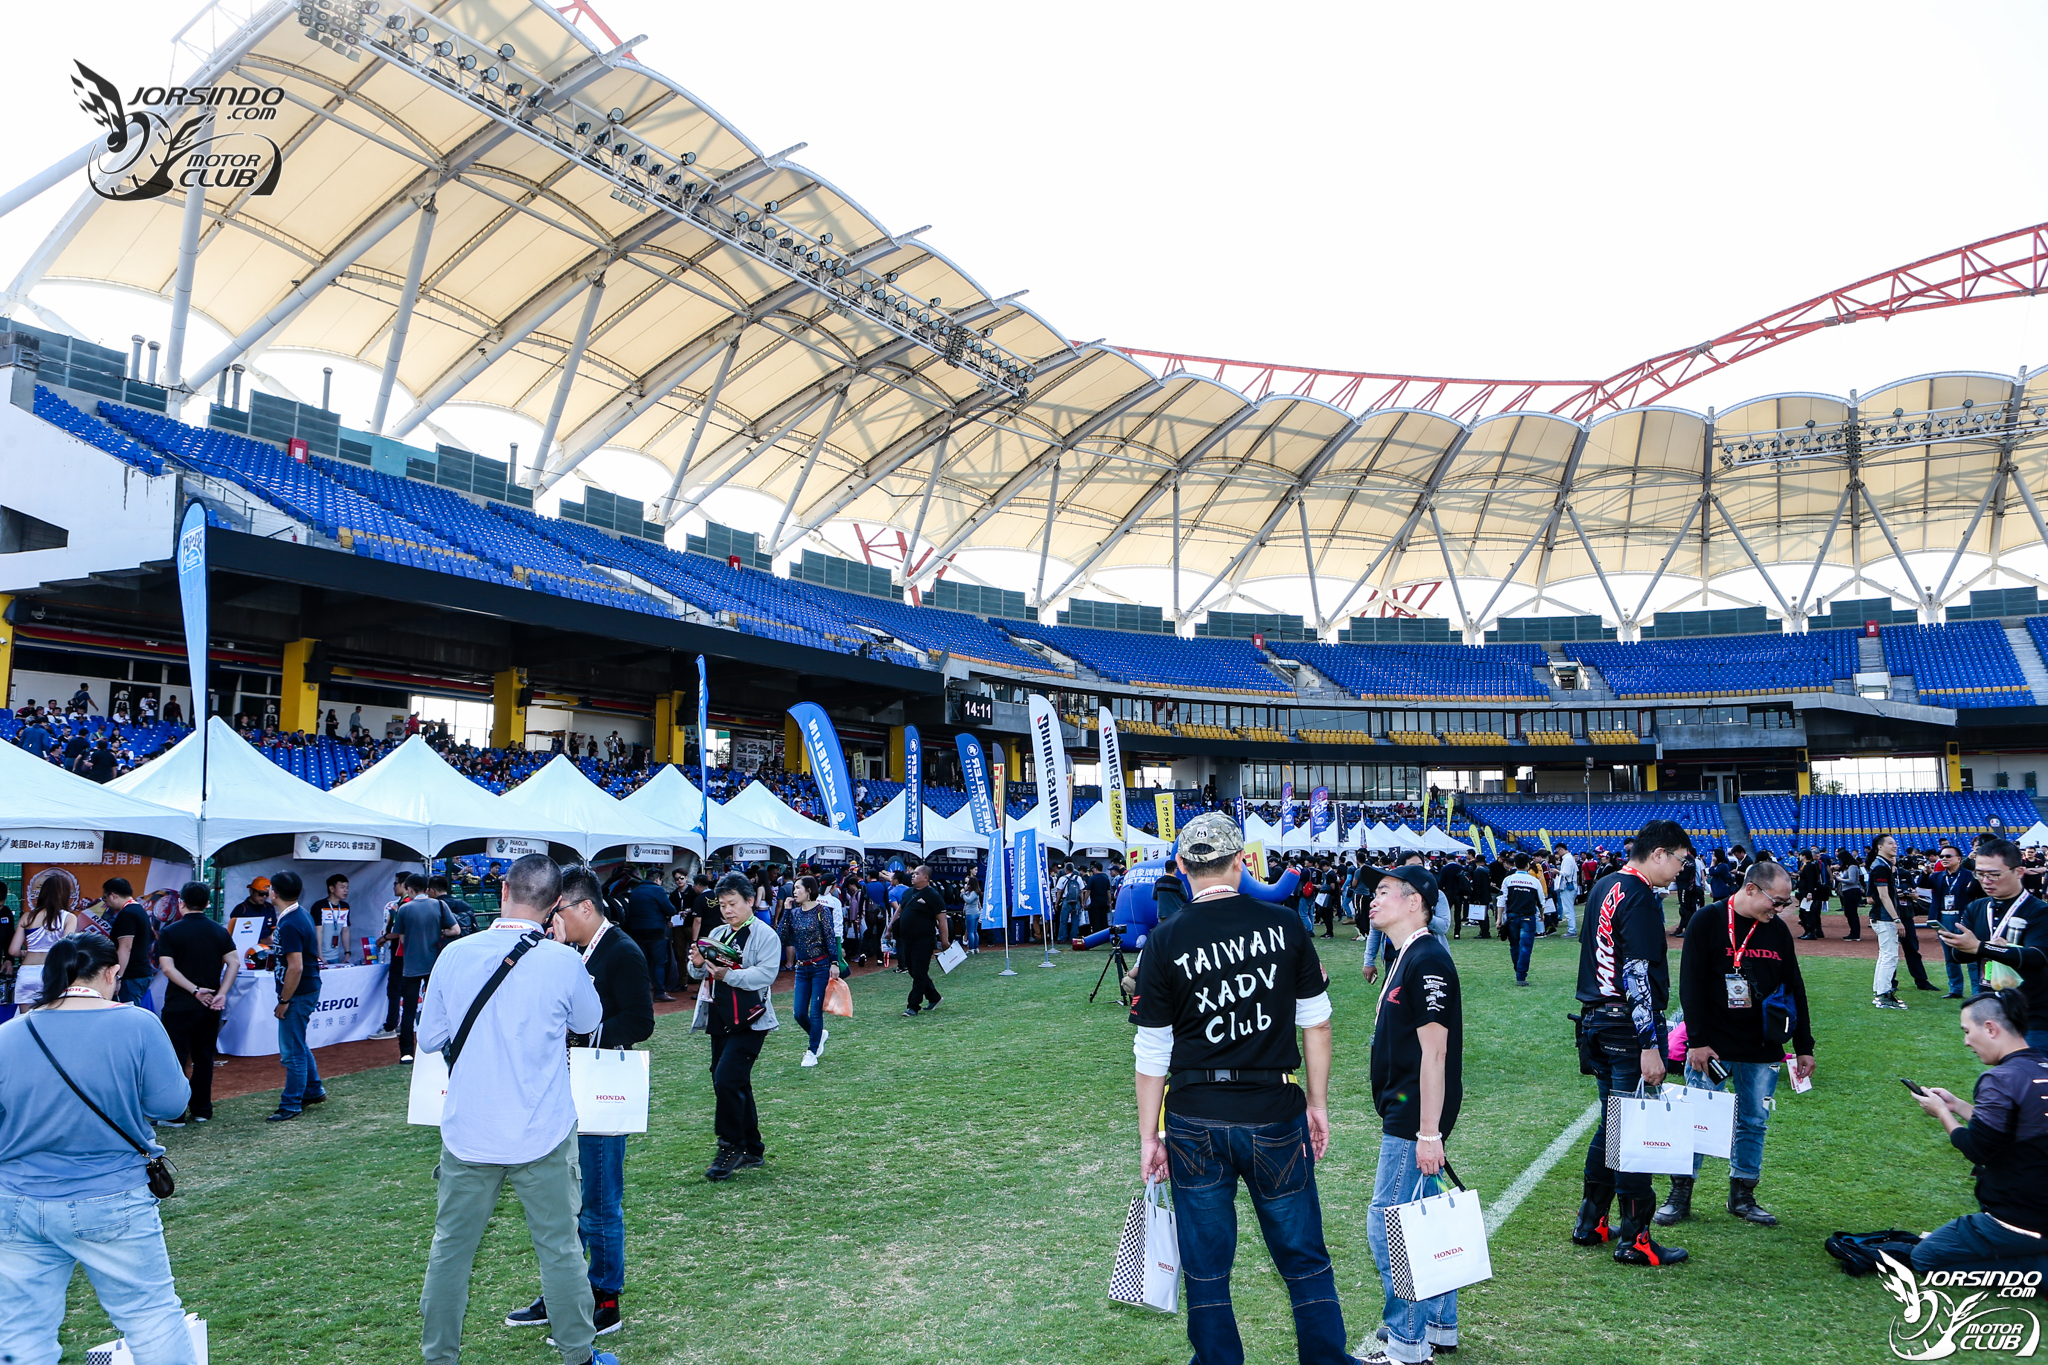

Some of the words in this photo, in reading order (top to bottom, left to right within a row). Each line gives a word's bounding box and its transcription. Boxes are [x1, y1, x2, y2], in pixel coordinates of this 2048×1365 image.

[965, 700, 991, 719] 14:11
[10, 840, 60, 850] 美國Bel-Ray
[61, 840, 95, 850] 培力機油
[325, 841, 350, 849] REPSOL
[593, 926, 606, 945] HONDA
[1595, 881, 1626, 997] MARQUEZ
[1173, 925, 1286, 980] TAIWAN
[1195, 963, 1278, 1013] XADV
[1205, 1002, 1272, 1044] Club
[1433, 1246, 1464, 1259] HONDA
[1157, 1261, 1175, 1273] HONDA
